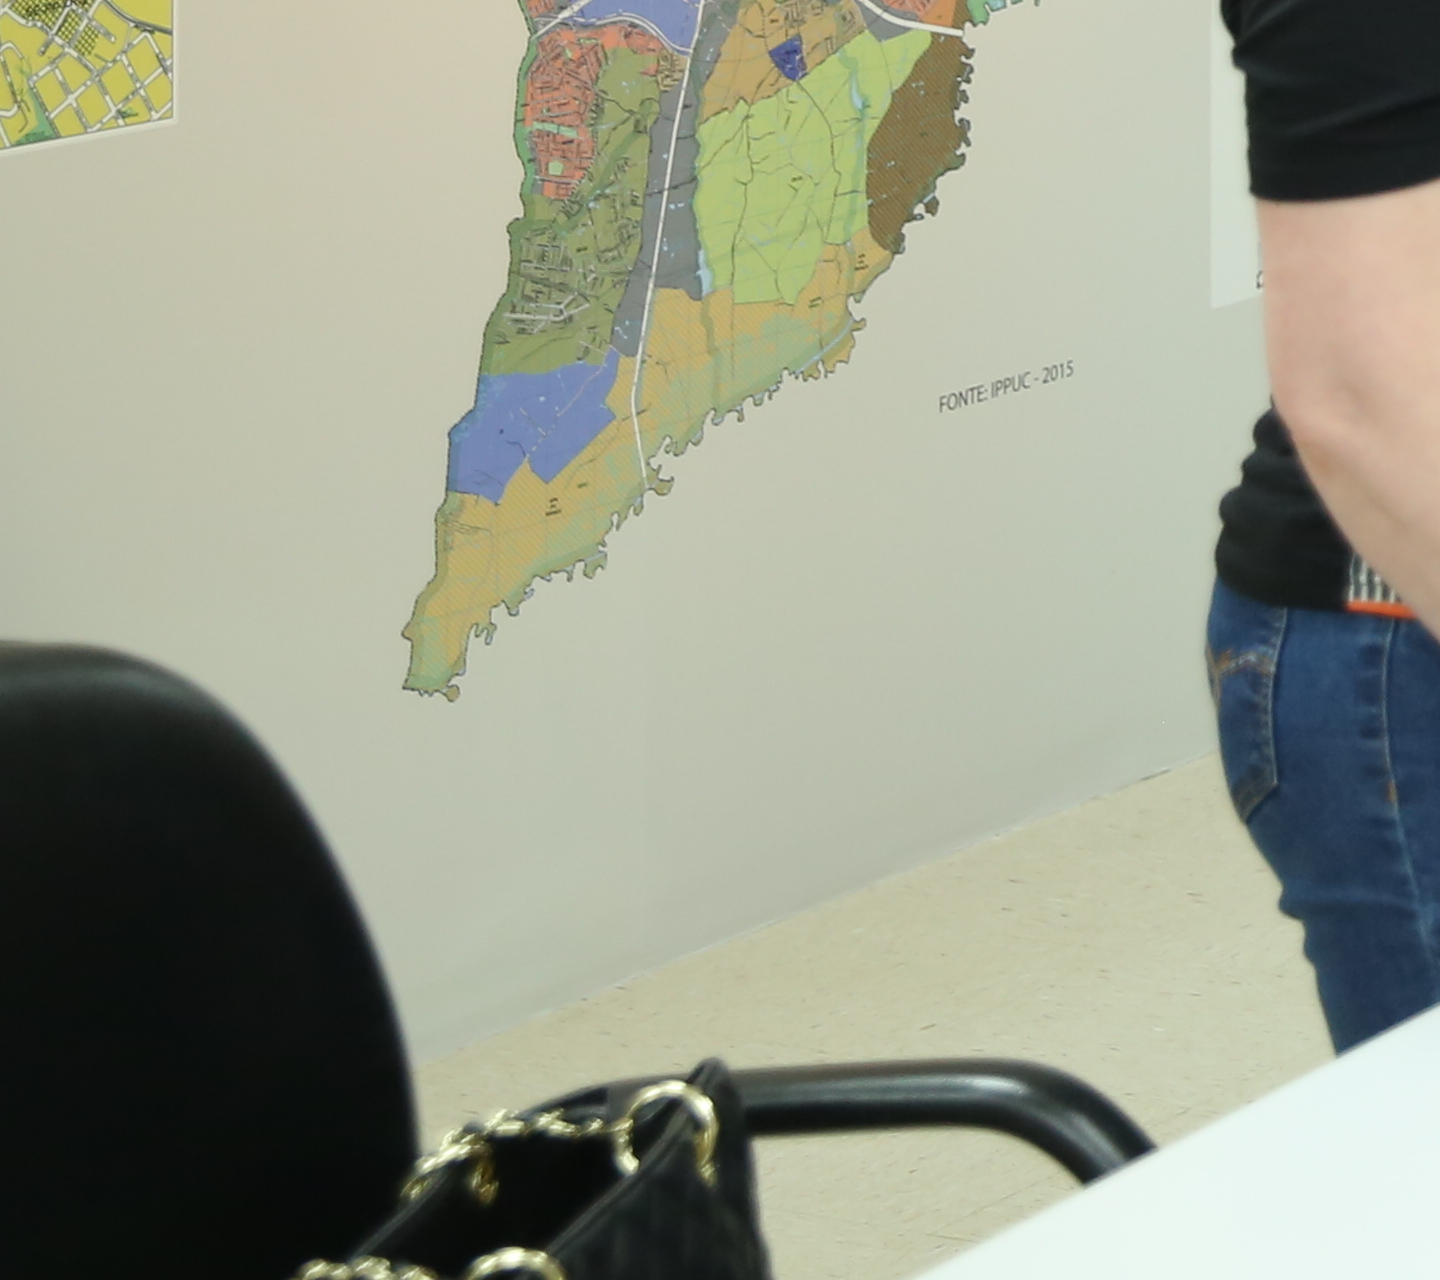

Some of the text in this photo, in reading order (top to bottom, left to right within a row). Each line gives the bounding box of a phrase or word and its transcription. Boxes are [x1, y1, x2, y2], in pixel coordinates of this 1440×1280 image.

[938, 385, 988, 413] FONTE:
[991, 371, 1031, 399] IPPUC
[1042, 360, 1075, 384] 2015
